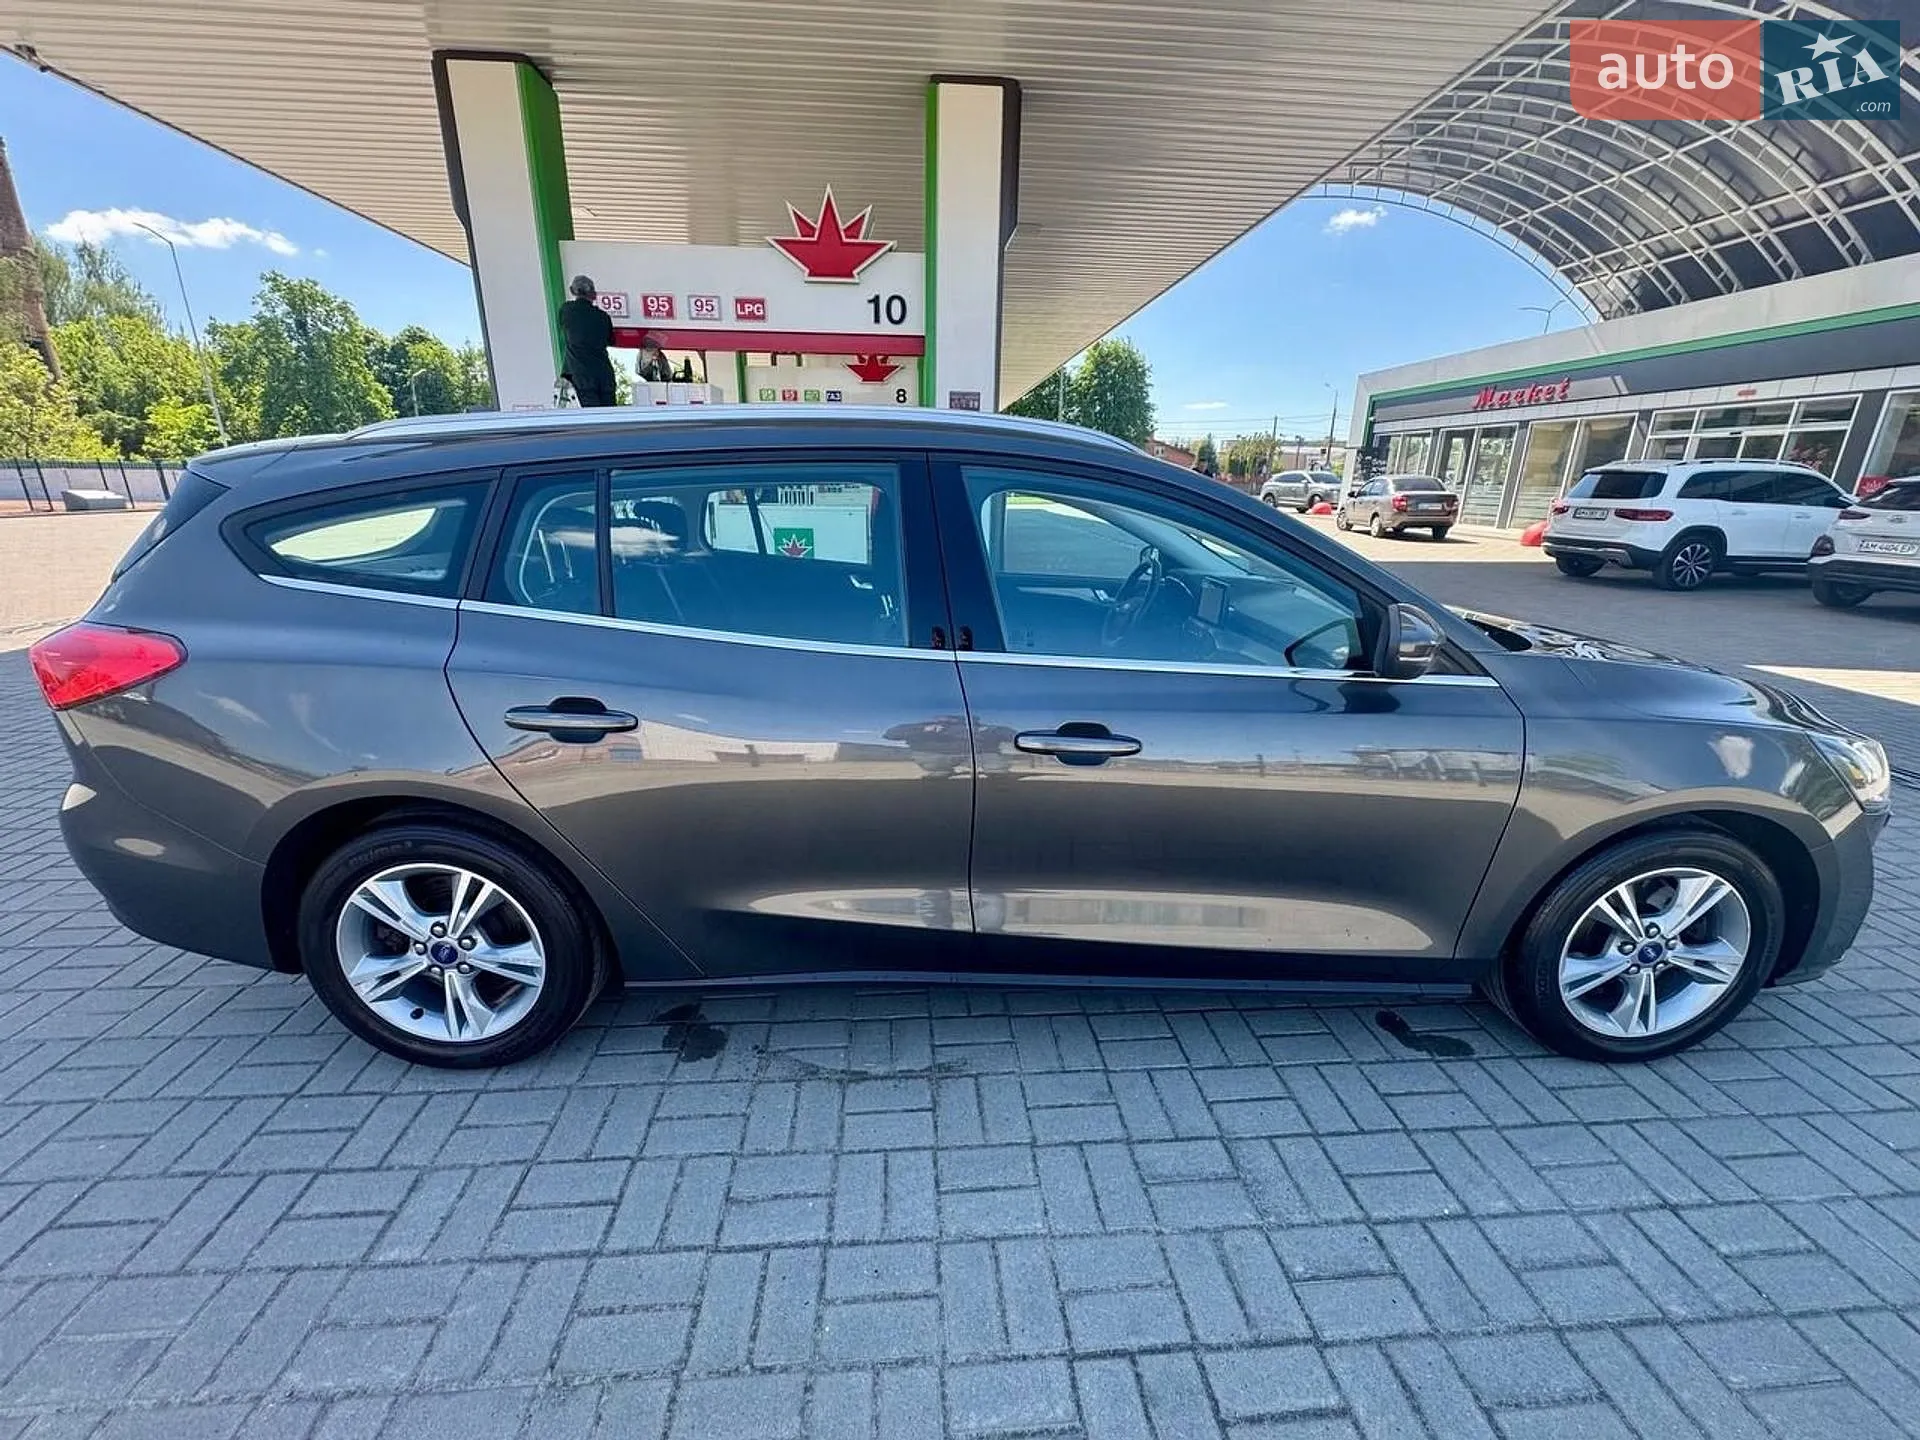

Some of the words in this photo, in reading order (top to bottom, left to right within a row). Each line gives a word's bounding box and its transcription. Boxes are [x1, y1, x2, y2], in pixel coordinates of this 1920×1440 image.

[601, 295, 623, 310] 95
[647, 296, 670, 311] 95
[694, 298, 714, 312] 95
[736, 303, 764, 316] LPG
[867, 293, 908, 326] 10
[895, 388, 907, 404] 8
[1472, 377, 1570, 410] Market
